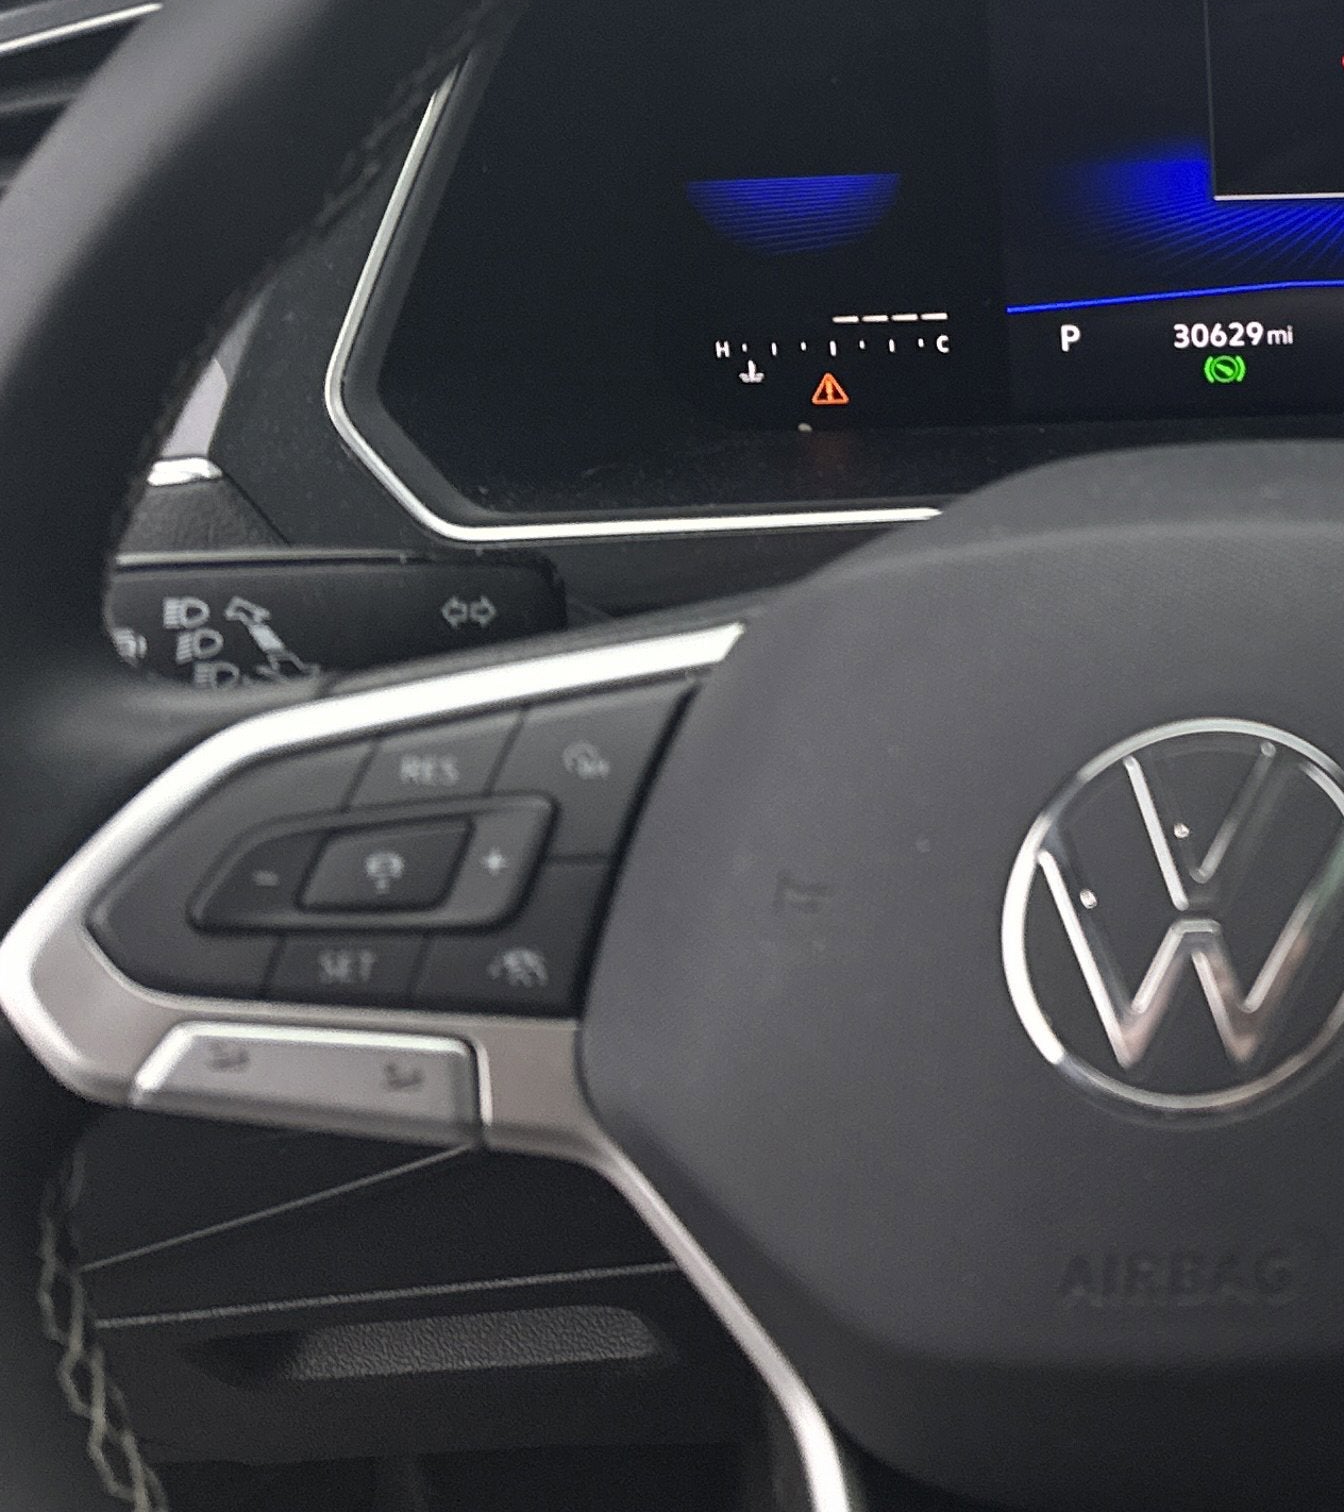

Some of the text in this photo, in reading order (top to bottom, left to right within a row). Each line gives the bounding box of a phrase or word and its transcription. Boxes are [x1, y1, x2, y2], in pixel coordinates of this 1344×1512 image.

[716, 340, 730, 358] H
[936, 335, 950, 354] C
[1060, 324, 1081, 352] P
[401, 755, 458, 783] RES
[319, 952, 374, 982] SET
[1060, 1251, 1302, 1307] AIRBAG
